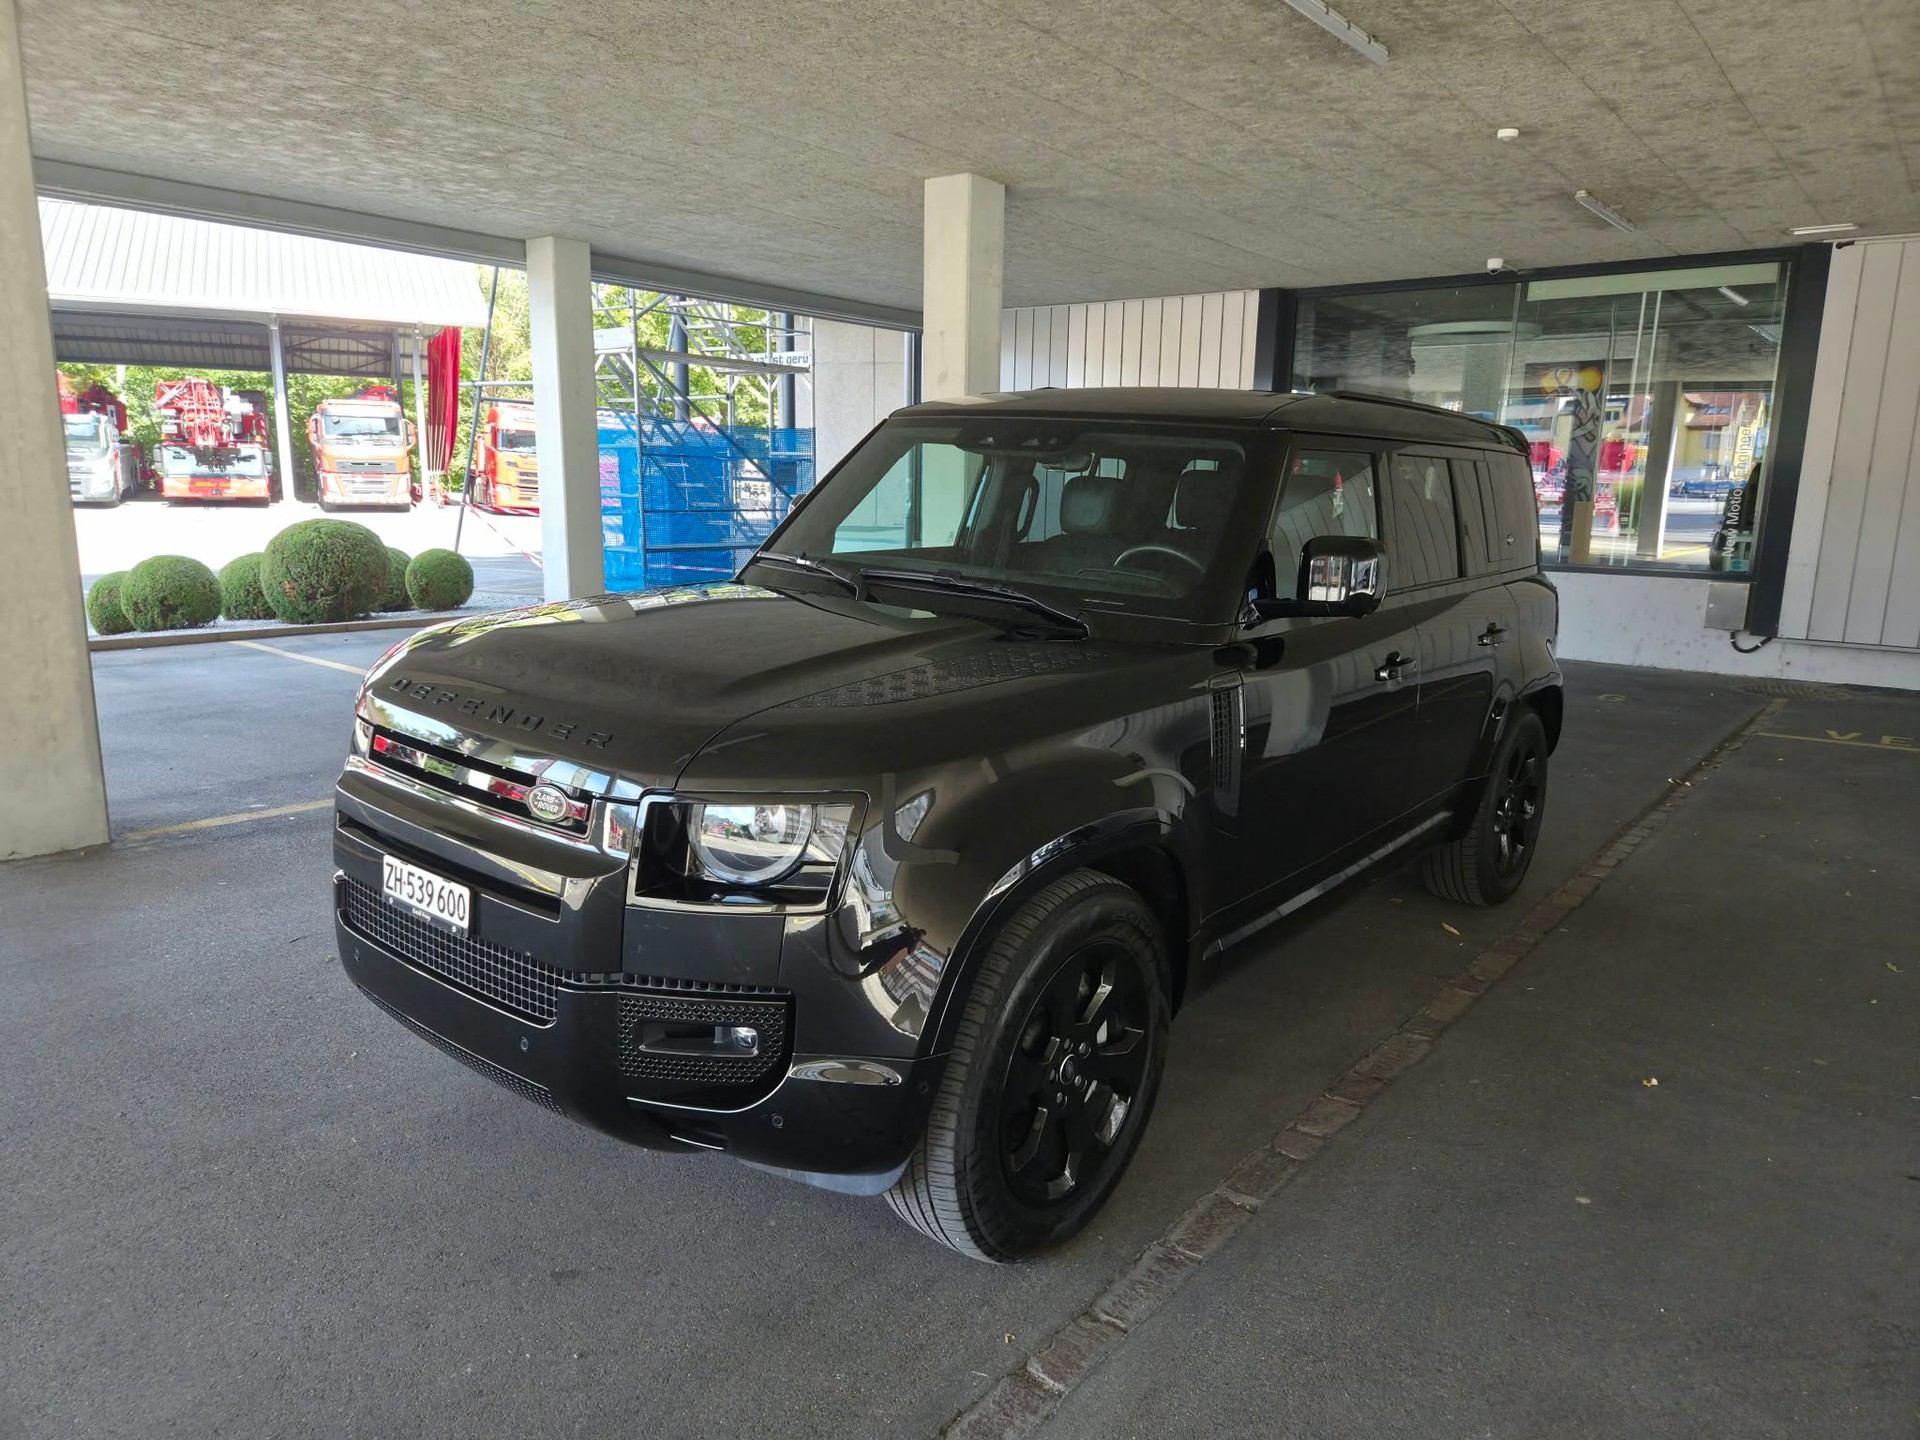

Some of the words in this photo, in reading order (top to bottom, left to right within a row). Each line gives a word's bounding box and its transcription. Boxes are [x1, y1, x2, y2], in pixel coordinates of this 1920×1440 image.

[1722, 527, 1738, 557] New
[389, 676, 613, 749] DEFENDER
[536, 791, 555, 804] LAND
[537, 801, 559, 813] ROVER
